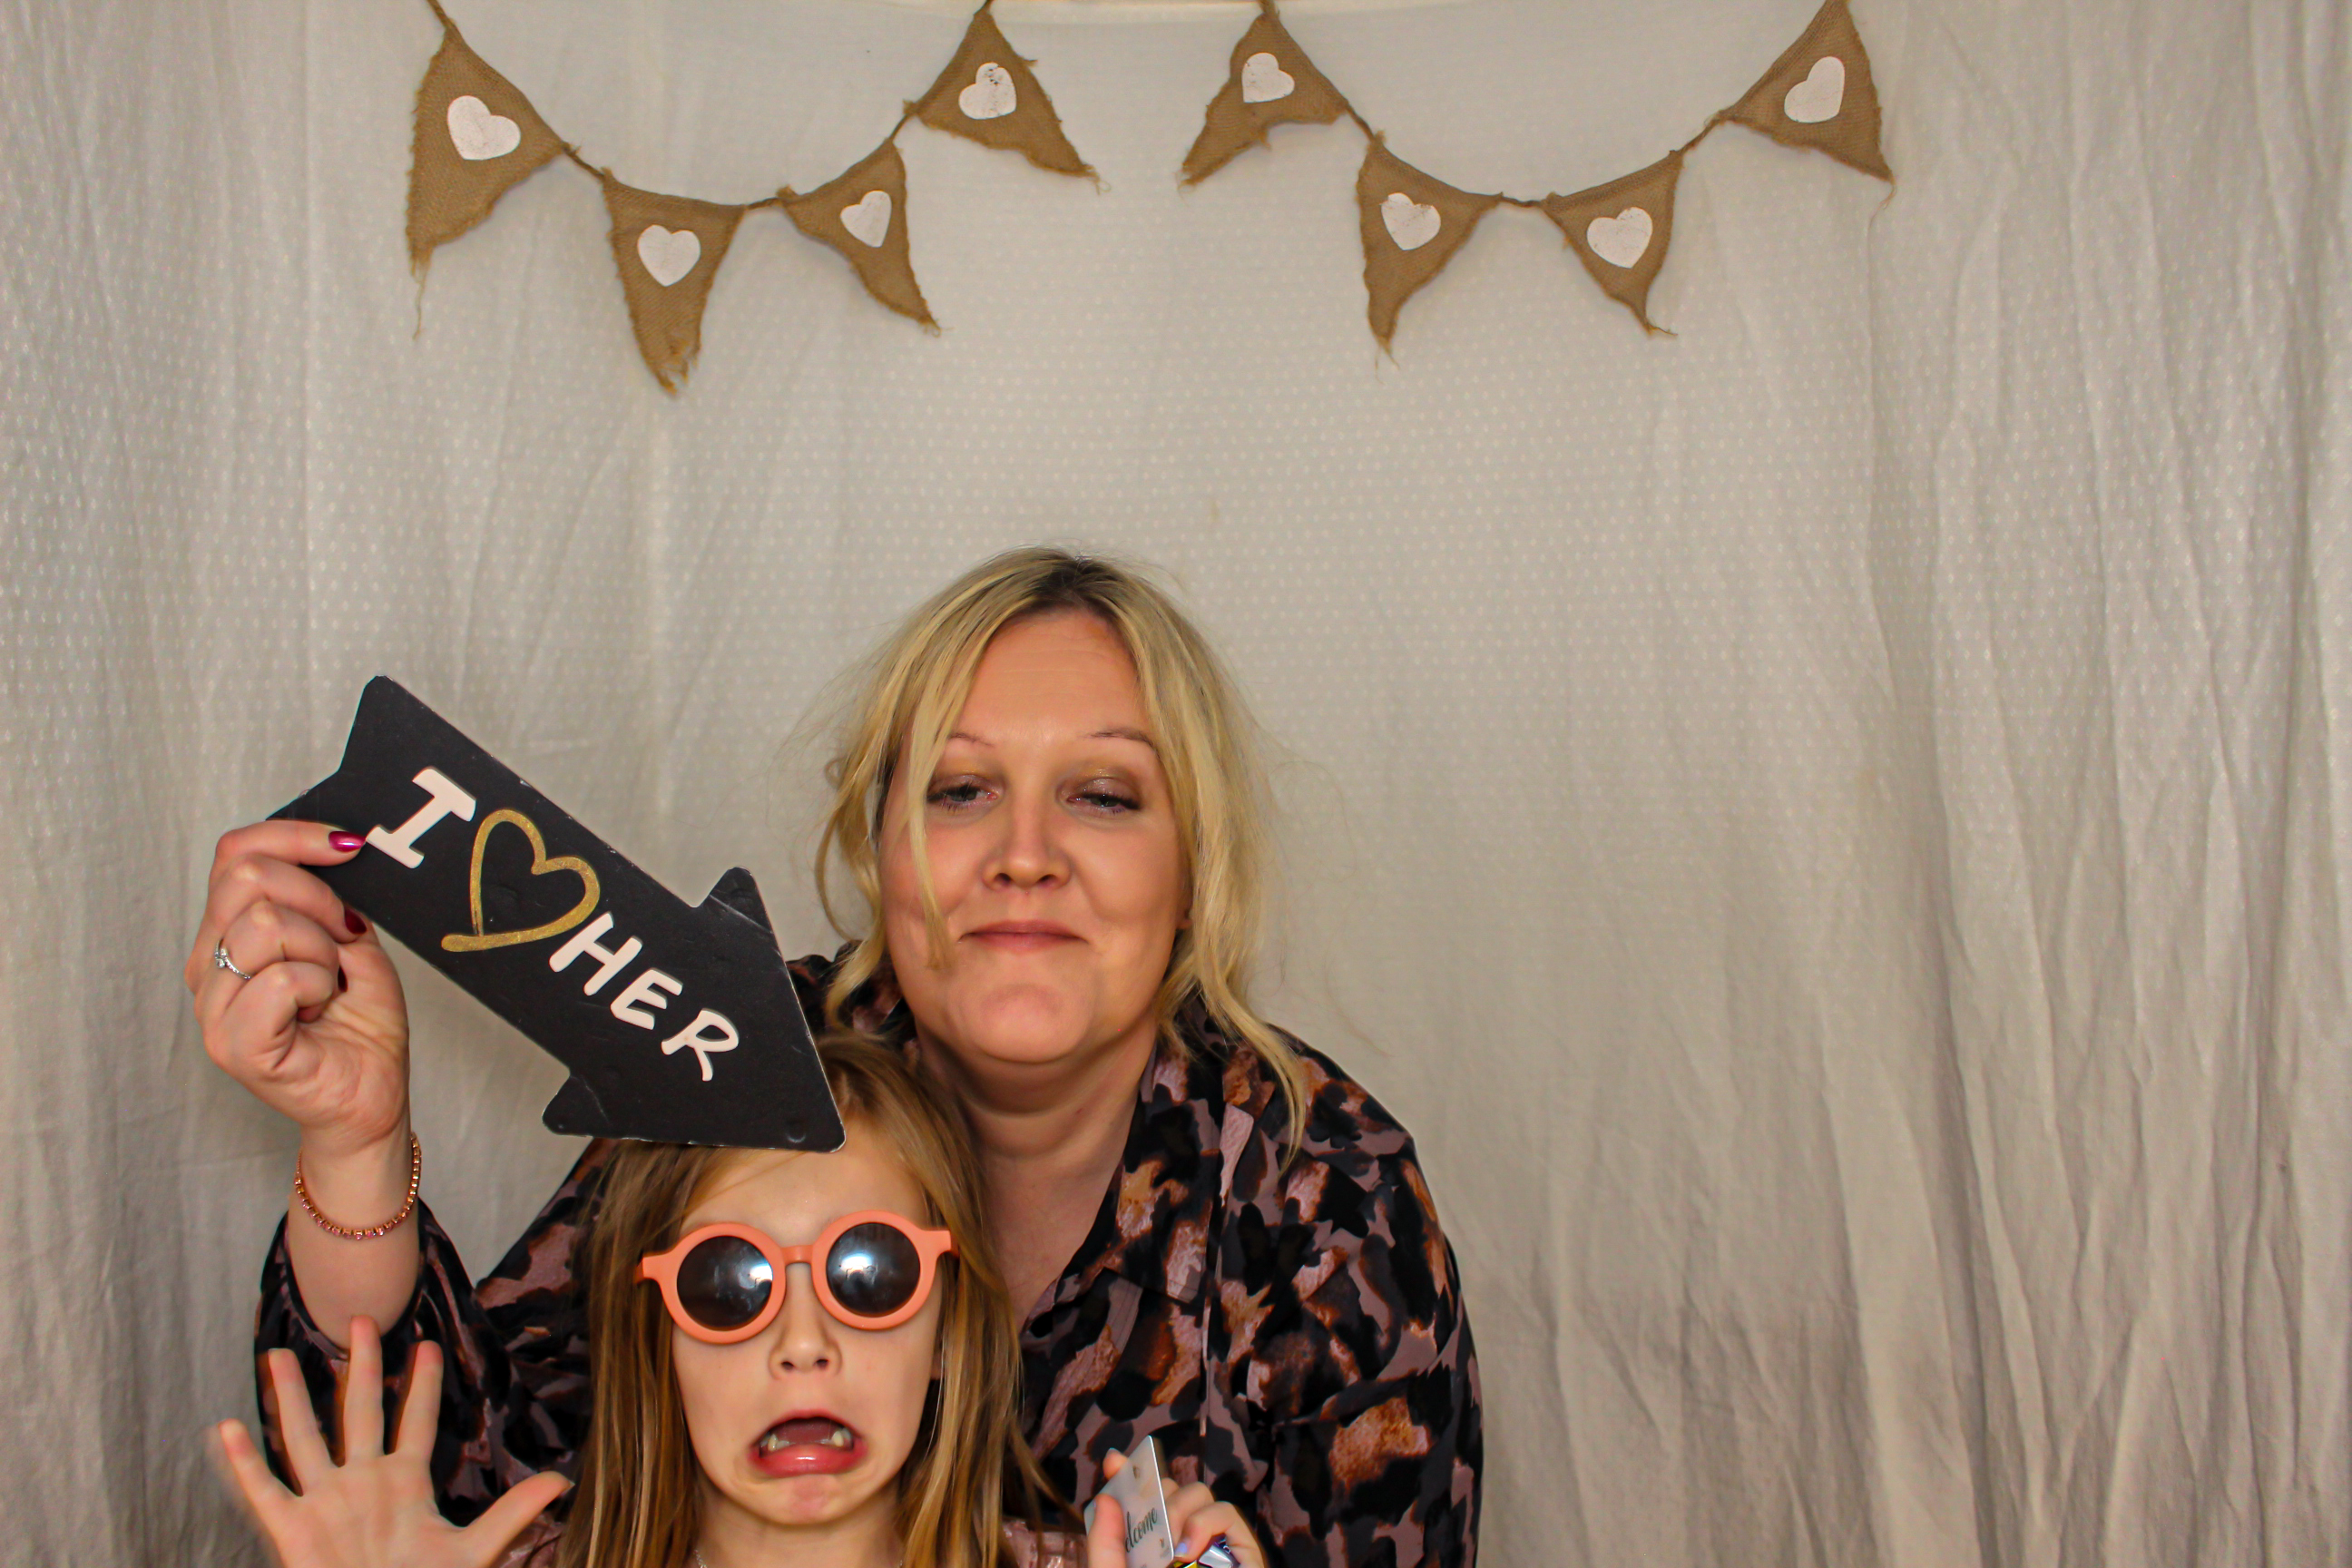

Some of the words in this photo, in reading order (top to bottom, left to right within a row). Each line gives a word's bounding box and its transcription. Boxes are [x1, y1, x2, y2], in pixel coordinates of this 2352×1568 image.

[365, 766, 476, 869] I
[548, 911, 740, 1082] HER
[1124, 1507, 1158, 1553] elcome
